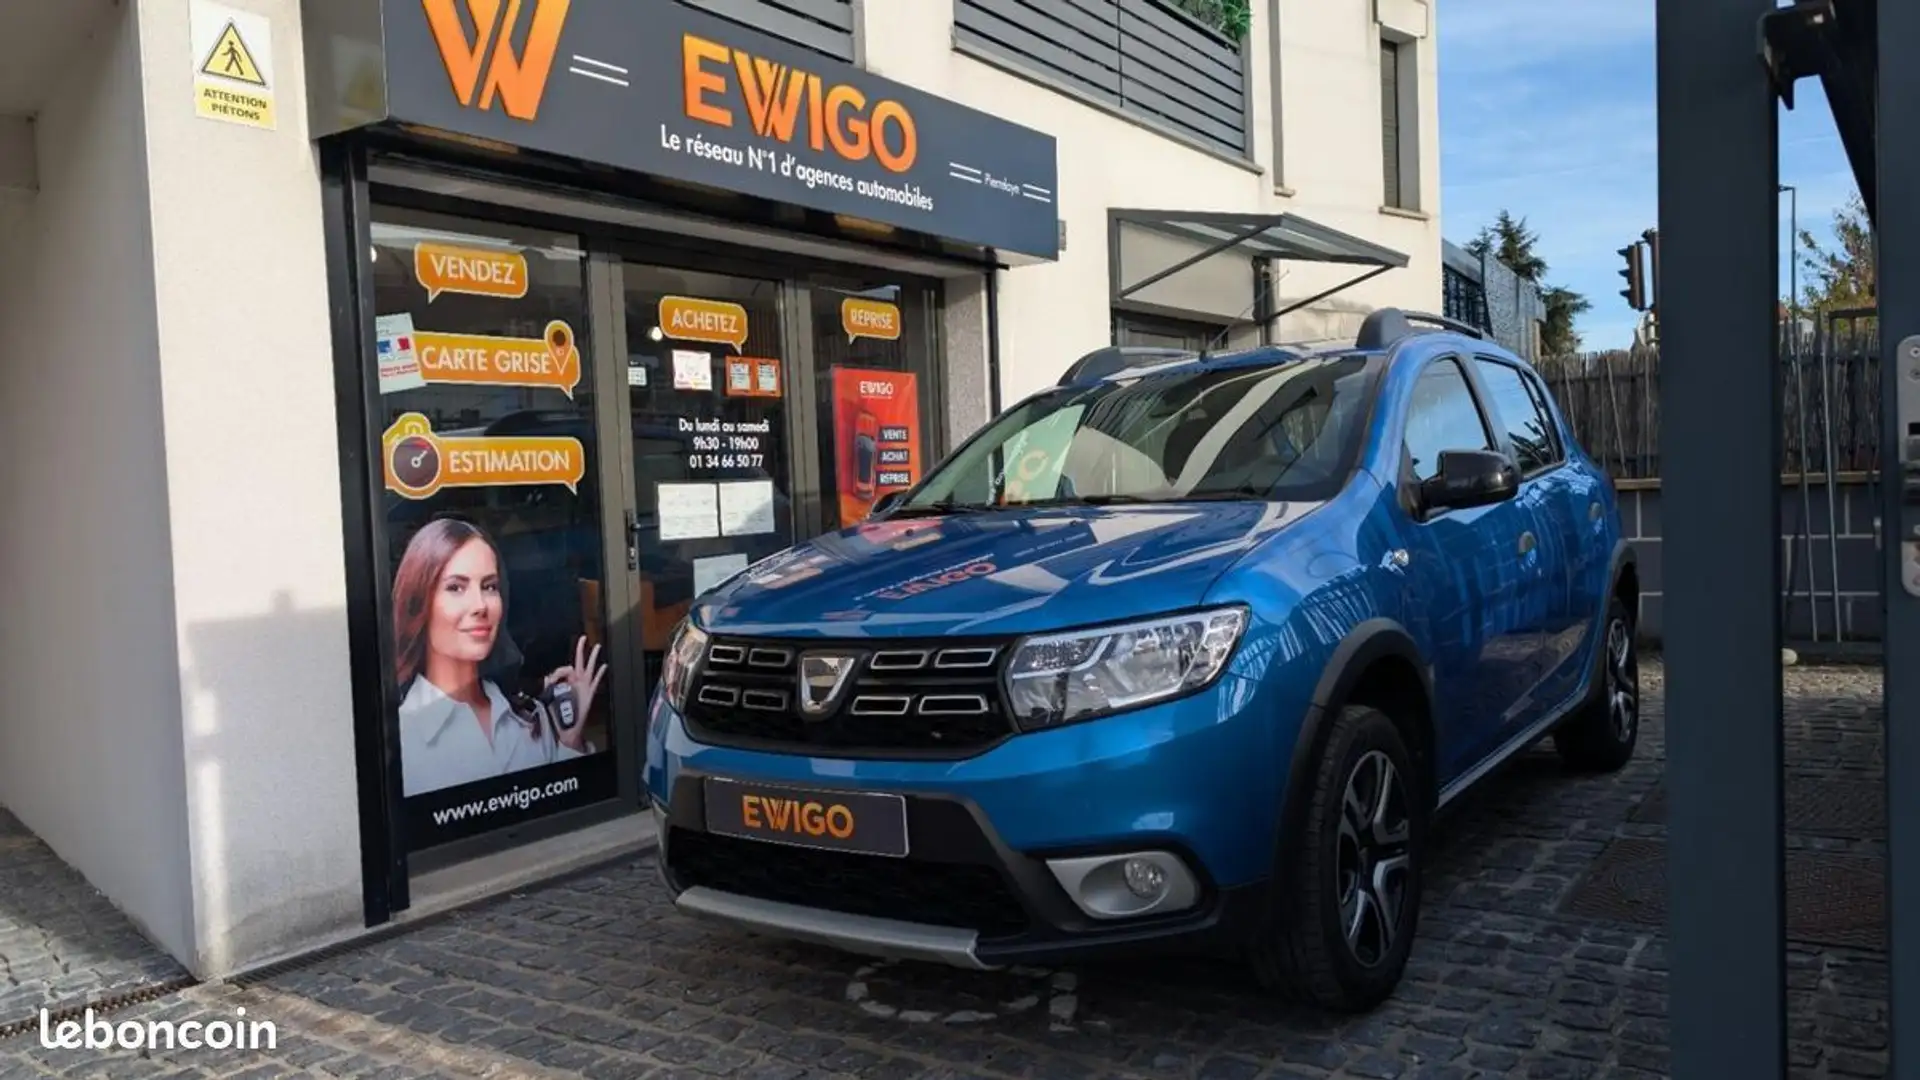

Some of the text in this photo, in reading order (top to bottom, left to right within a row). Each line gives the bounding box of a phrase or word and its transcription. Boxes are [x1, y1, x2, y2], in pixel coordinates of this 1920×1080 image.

[204, 88, 267, 109] ATTENTION
[683, 33, 917, 173] EWIGO
[211, 102, 260, 120] PIÉTONS
[661, 124, 934, 211] Le réseau N°1 d'agences automobiles
[430, 253, 516, 285] VENDEZ
[671, 308, 739, 333] ACHETEZ
[850, 308, 894, 329] REPRISE
[422, 345, 488, 372] CARTE
[494, 350, 552, 374] GRISE
[860, 381, 894, 395] EWIGO
[678, 418, 770, 433] Du lundi au samedi
[882, 429, 907, 440] VENTE
[693, 436, 719, 450] 9h30
[729, 437, 759, 450] 19h00
[450, 449, 570, 473] ESTIMATION
[689, 454, 764, 468] 01 34 66 50 77
[882, 452, 908, 462] ACHAT
[432, 776, 578, 826] www.ewigo.com
[742, 795, 854, 838] EWIGO
